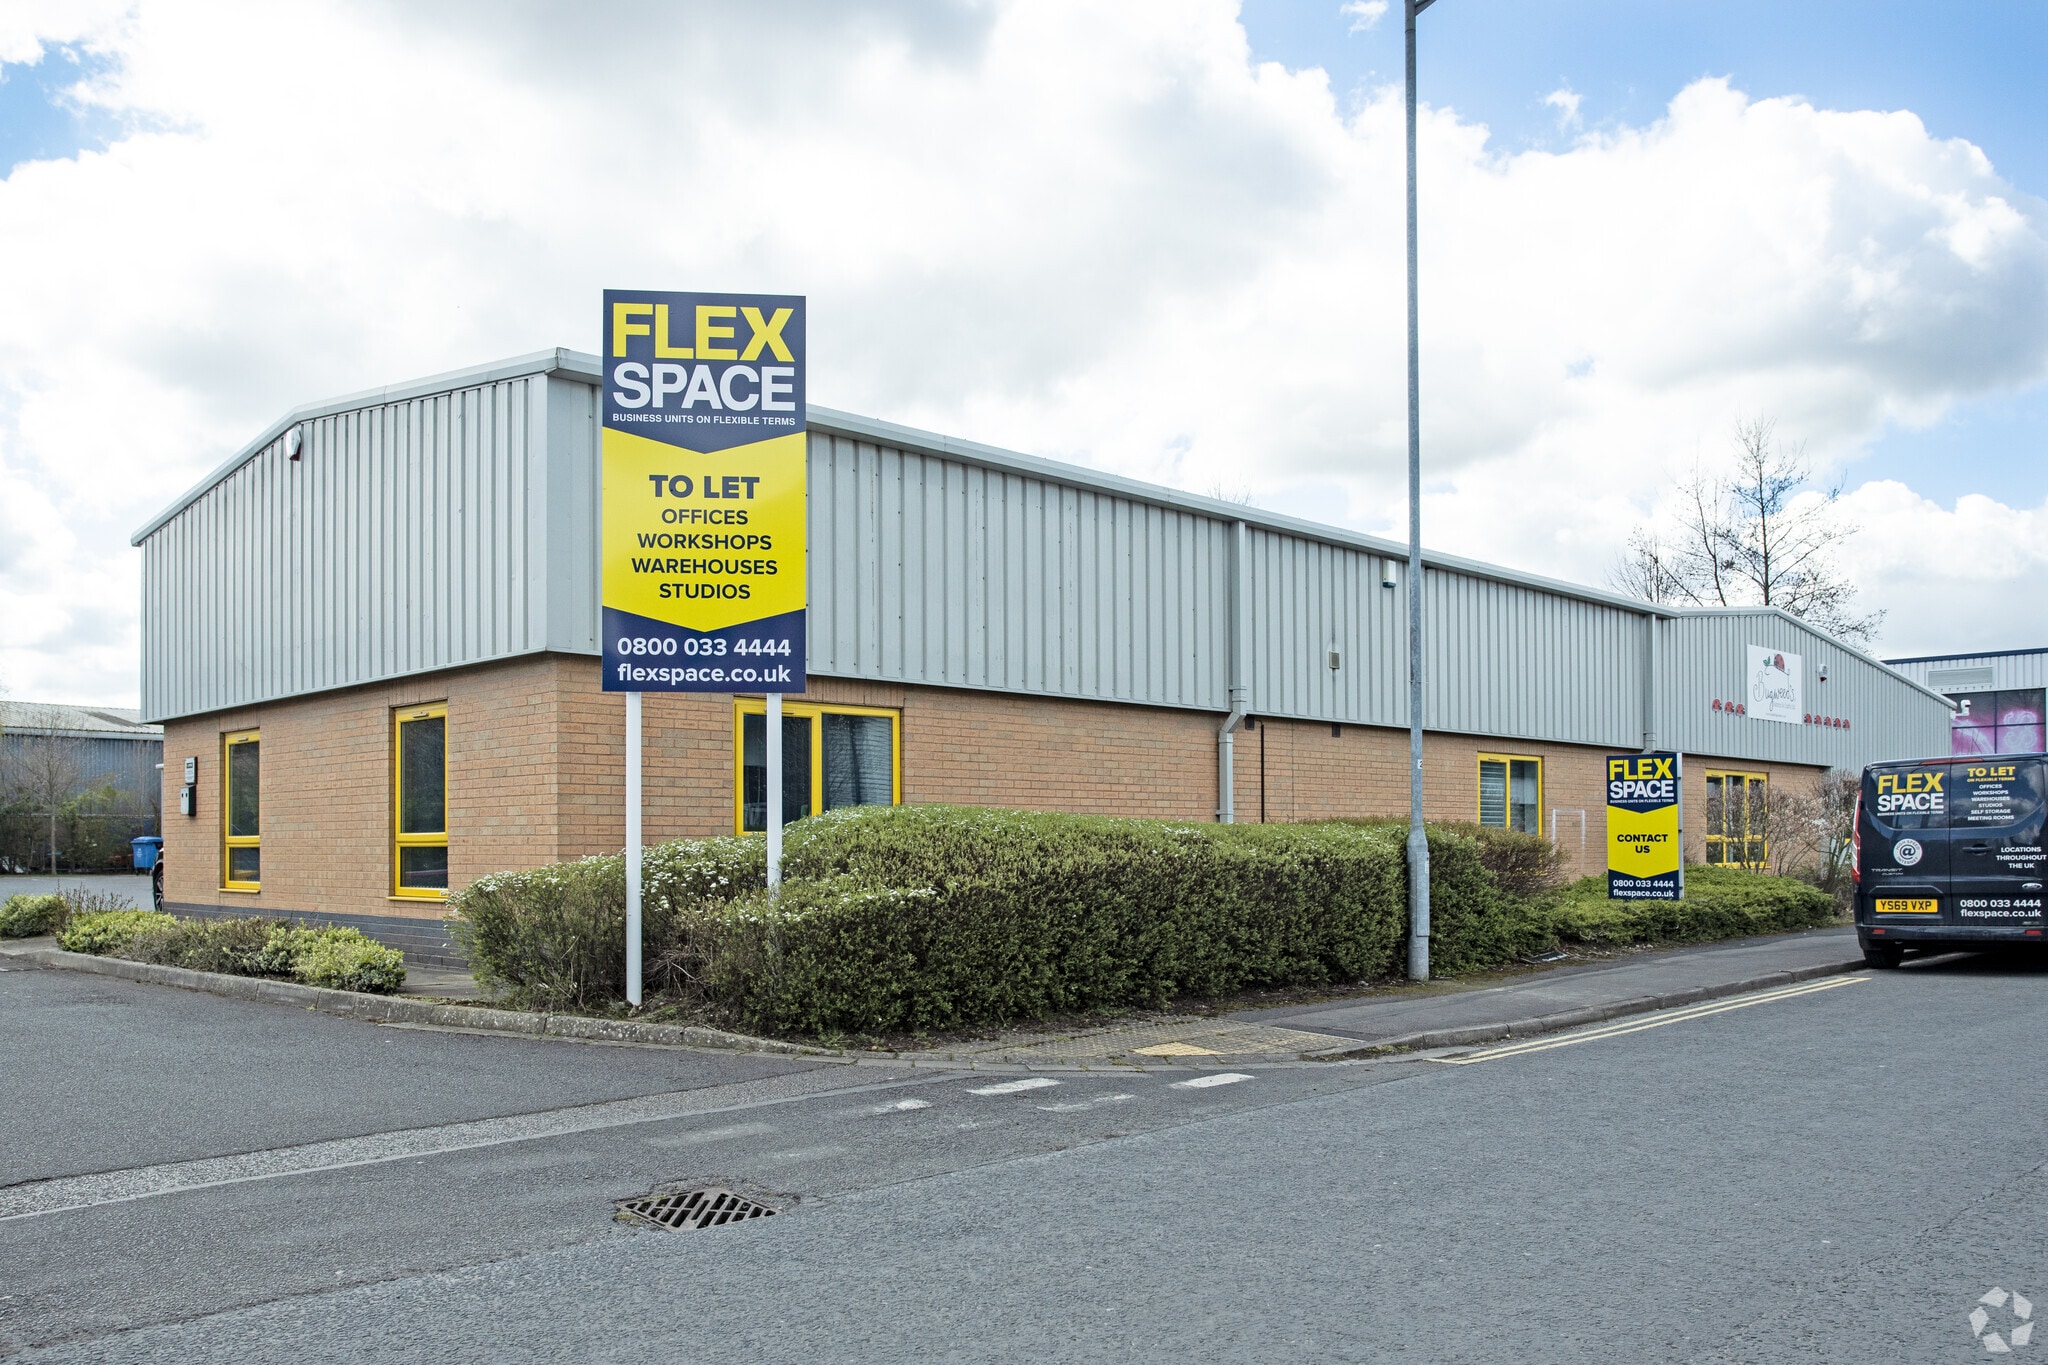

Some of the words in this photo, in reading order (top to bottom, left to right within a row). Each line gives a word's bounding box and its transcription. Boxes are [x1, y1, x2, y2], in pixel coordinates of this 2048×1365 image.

[613, 303, 795, 362] FLEX
[613, 362, 796, 411] SPACE
[612, 413, 662, 422] BUSINESS
[665, 415, 694, 423] UNITS
[696, 415, 711, 423] ON
[714, 416, 759, 425] FLEXIBLE
[762, 417, 795, 426] TERMS
[649, 475, 694, 498] TO
[703, 476, 760, 499] LET
[661, 508, 748, 525] OFFICES
[637, 533, 772, 550] WORKSHOPS
[631, 558, 778, 575] WAREHOUSES
[659, 583, 751, 599] STUDIOS
[617, 638, 677, 655] 0800
[684, 638, 727, 656] 033
[734, 638, 791, 657] 4444
[618, 663, 791, 685] flexspace.co.uk
[1609, 758, 1673, 780] FLEX
[1967, 767, 1987, 777] TO
[1990, 766, 2016, 776] LET
[1610, 780, 1674, 799] SPACE
[1877, 772, 1944, 794] FLEX
[1877, 793, 1944, 812] SPACE
[1617, 834, 1668, 843] CONTACT
[1635, 845, 1650, 853] US
[1900, 845, 1916, 859] @
[1653, 880, 1674, 888] 4444
[1613, 889, 1674, 898] flexspace.co.uk
[1880, 901, 1908, 910] YS69
[1911, 901, 1932, 910] VXP
[1960, 899, 1987, 907] 0800
[1990, 899, 2010, 907] 033
[2013, 899, 2042, 907] 4444
[1960, 909, 2042, 919] flexspace.co.uk
